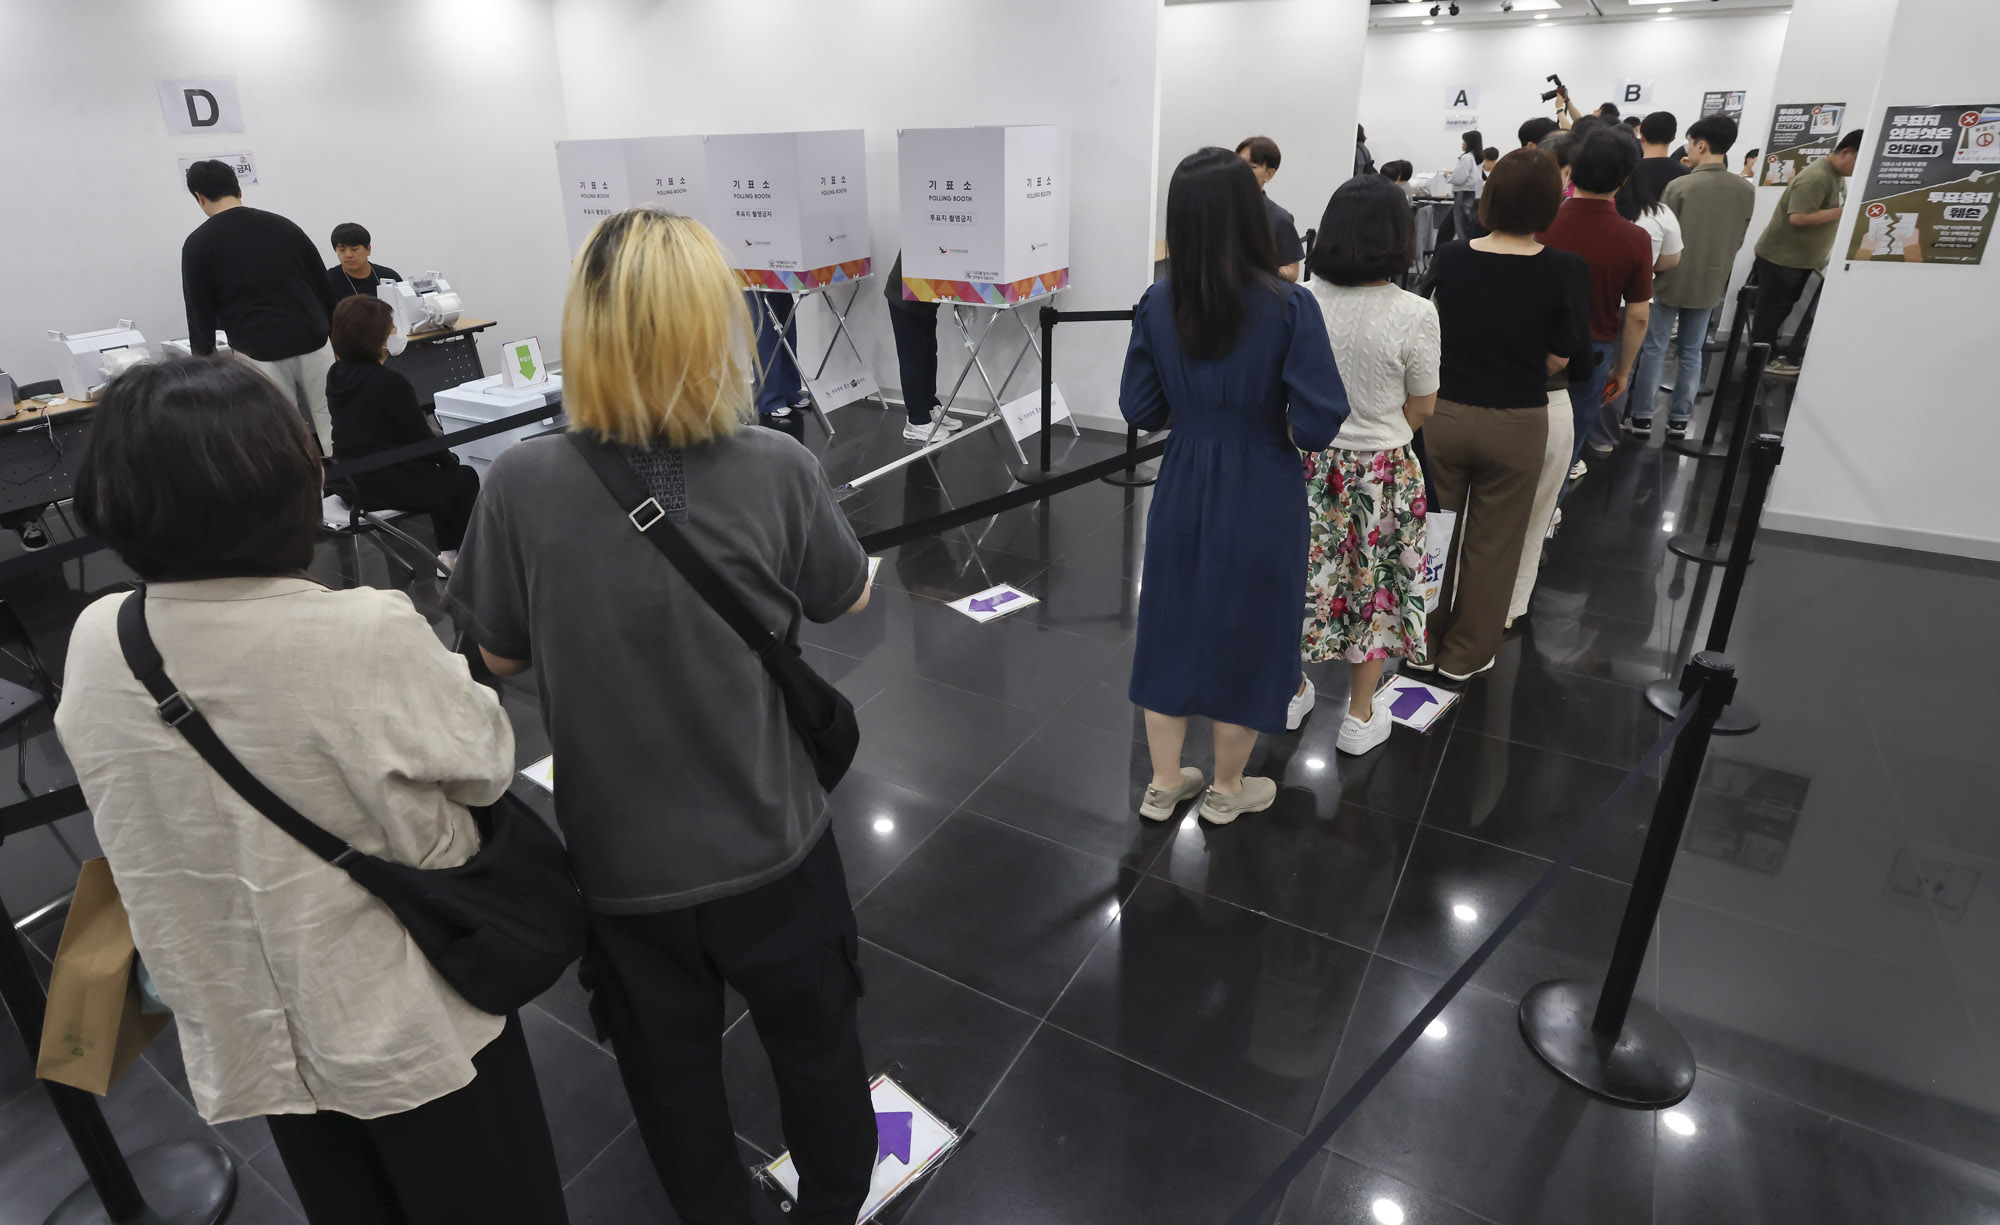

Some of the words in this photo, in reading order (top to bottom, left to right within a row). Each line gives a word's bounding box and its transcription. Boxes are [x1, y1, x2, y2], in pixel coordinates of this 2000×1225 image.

[1453, 89, 1469, 106] A
[1624, 84, 1641, 102] B
[183, 89, 219, 127] D
[1892, 114, 1941, 126] 투표지
[1889, 127, 1953, 139] 인증샷은
[1887, 144, 1938, 155] 안돼요!
[236, 164, 252, 173] 금지
[1927, 192, 1993, 204] 투표용지
[751, 210, 772, 218] 촬영금지
[929, 214, 947, 222] 투표지
[948, 214, 973, 223] 촬영금지
[1949, 208, 1981, 219] 훼손
